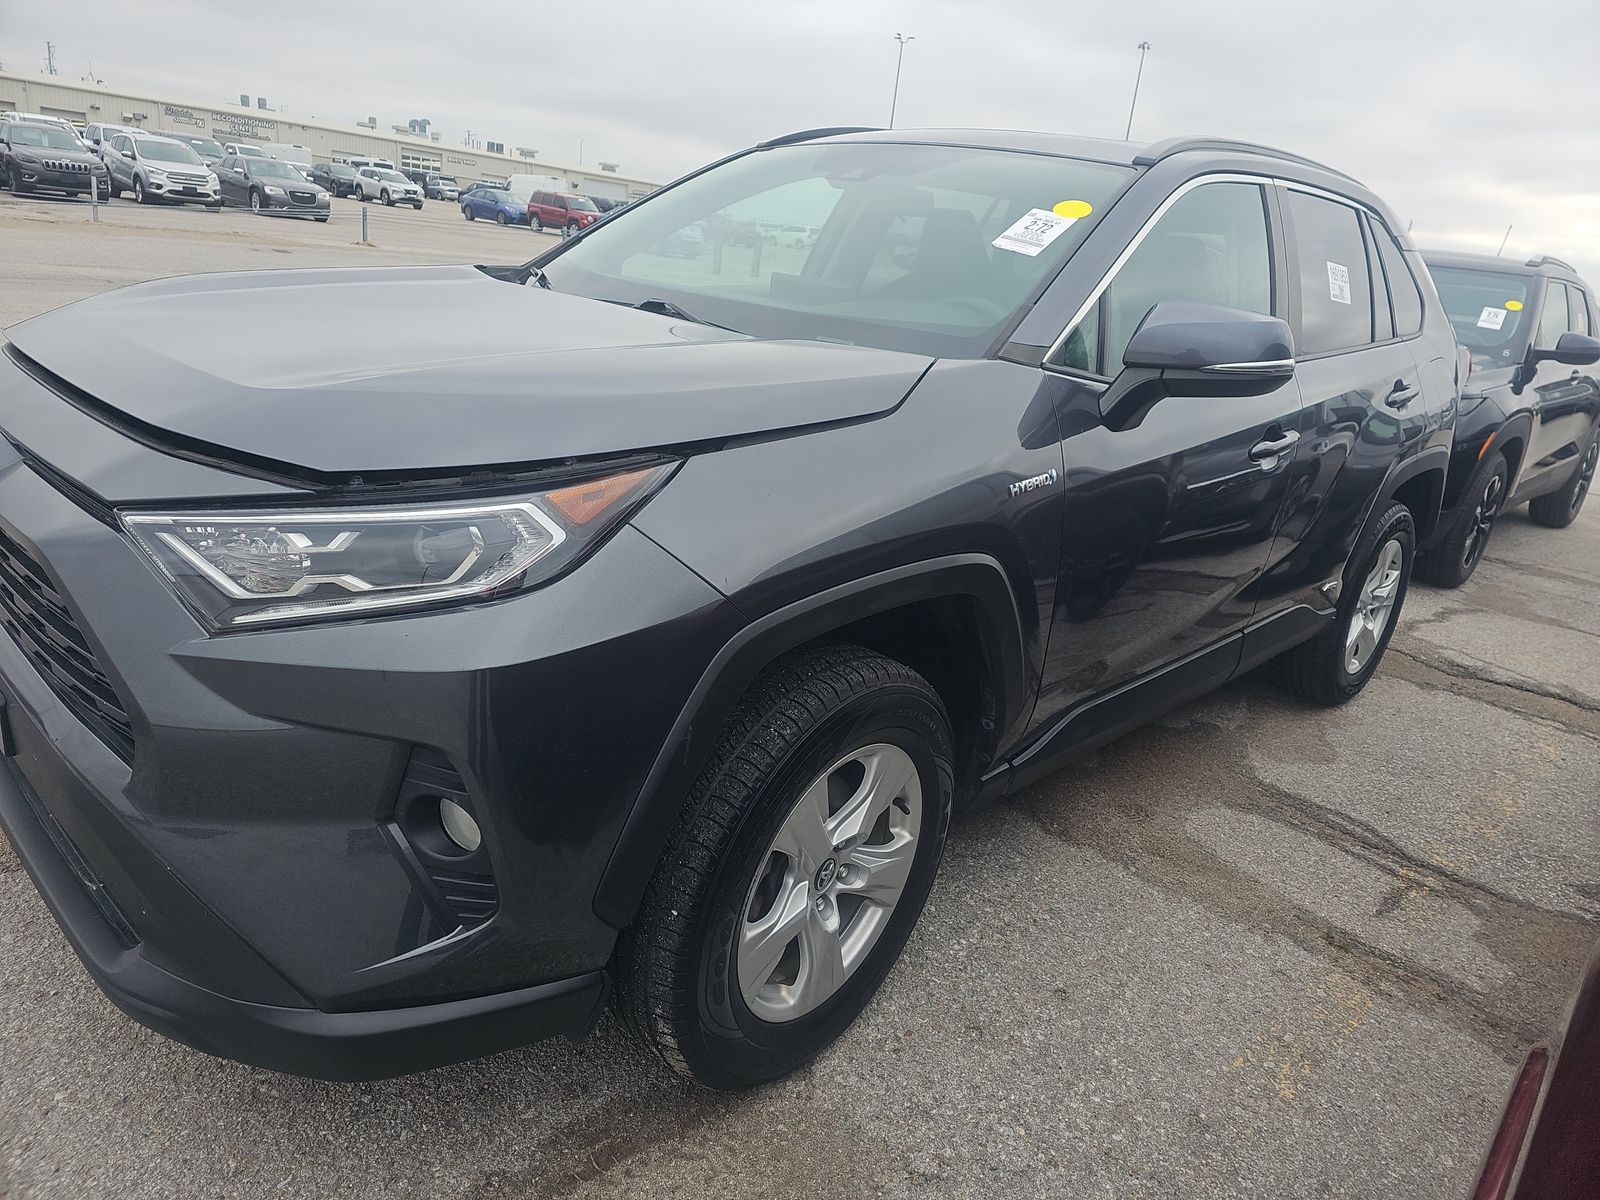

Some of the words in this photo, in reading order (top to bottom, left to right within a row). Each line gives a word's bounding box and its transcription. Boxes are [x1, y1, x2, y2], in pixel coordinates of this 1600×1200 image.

[211, 113, 275, 129] RECONDITIONING
[229, 122, 258, 134] CENTER
[1008, 473, 1051, 497] HYBRID
